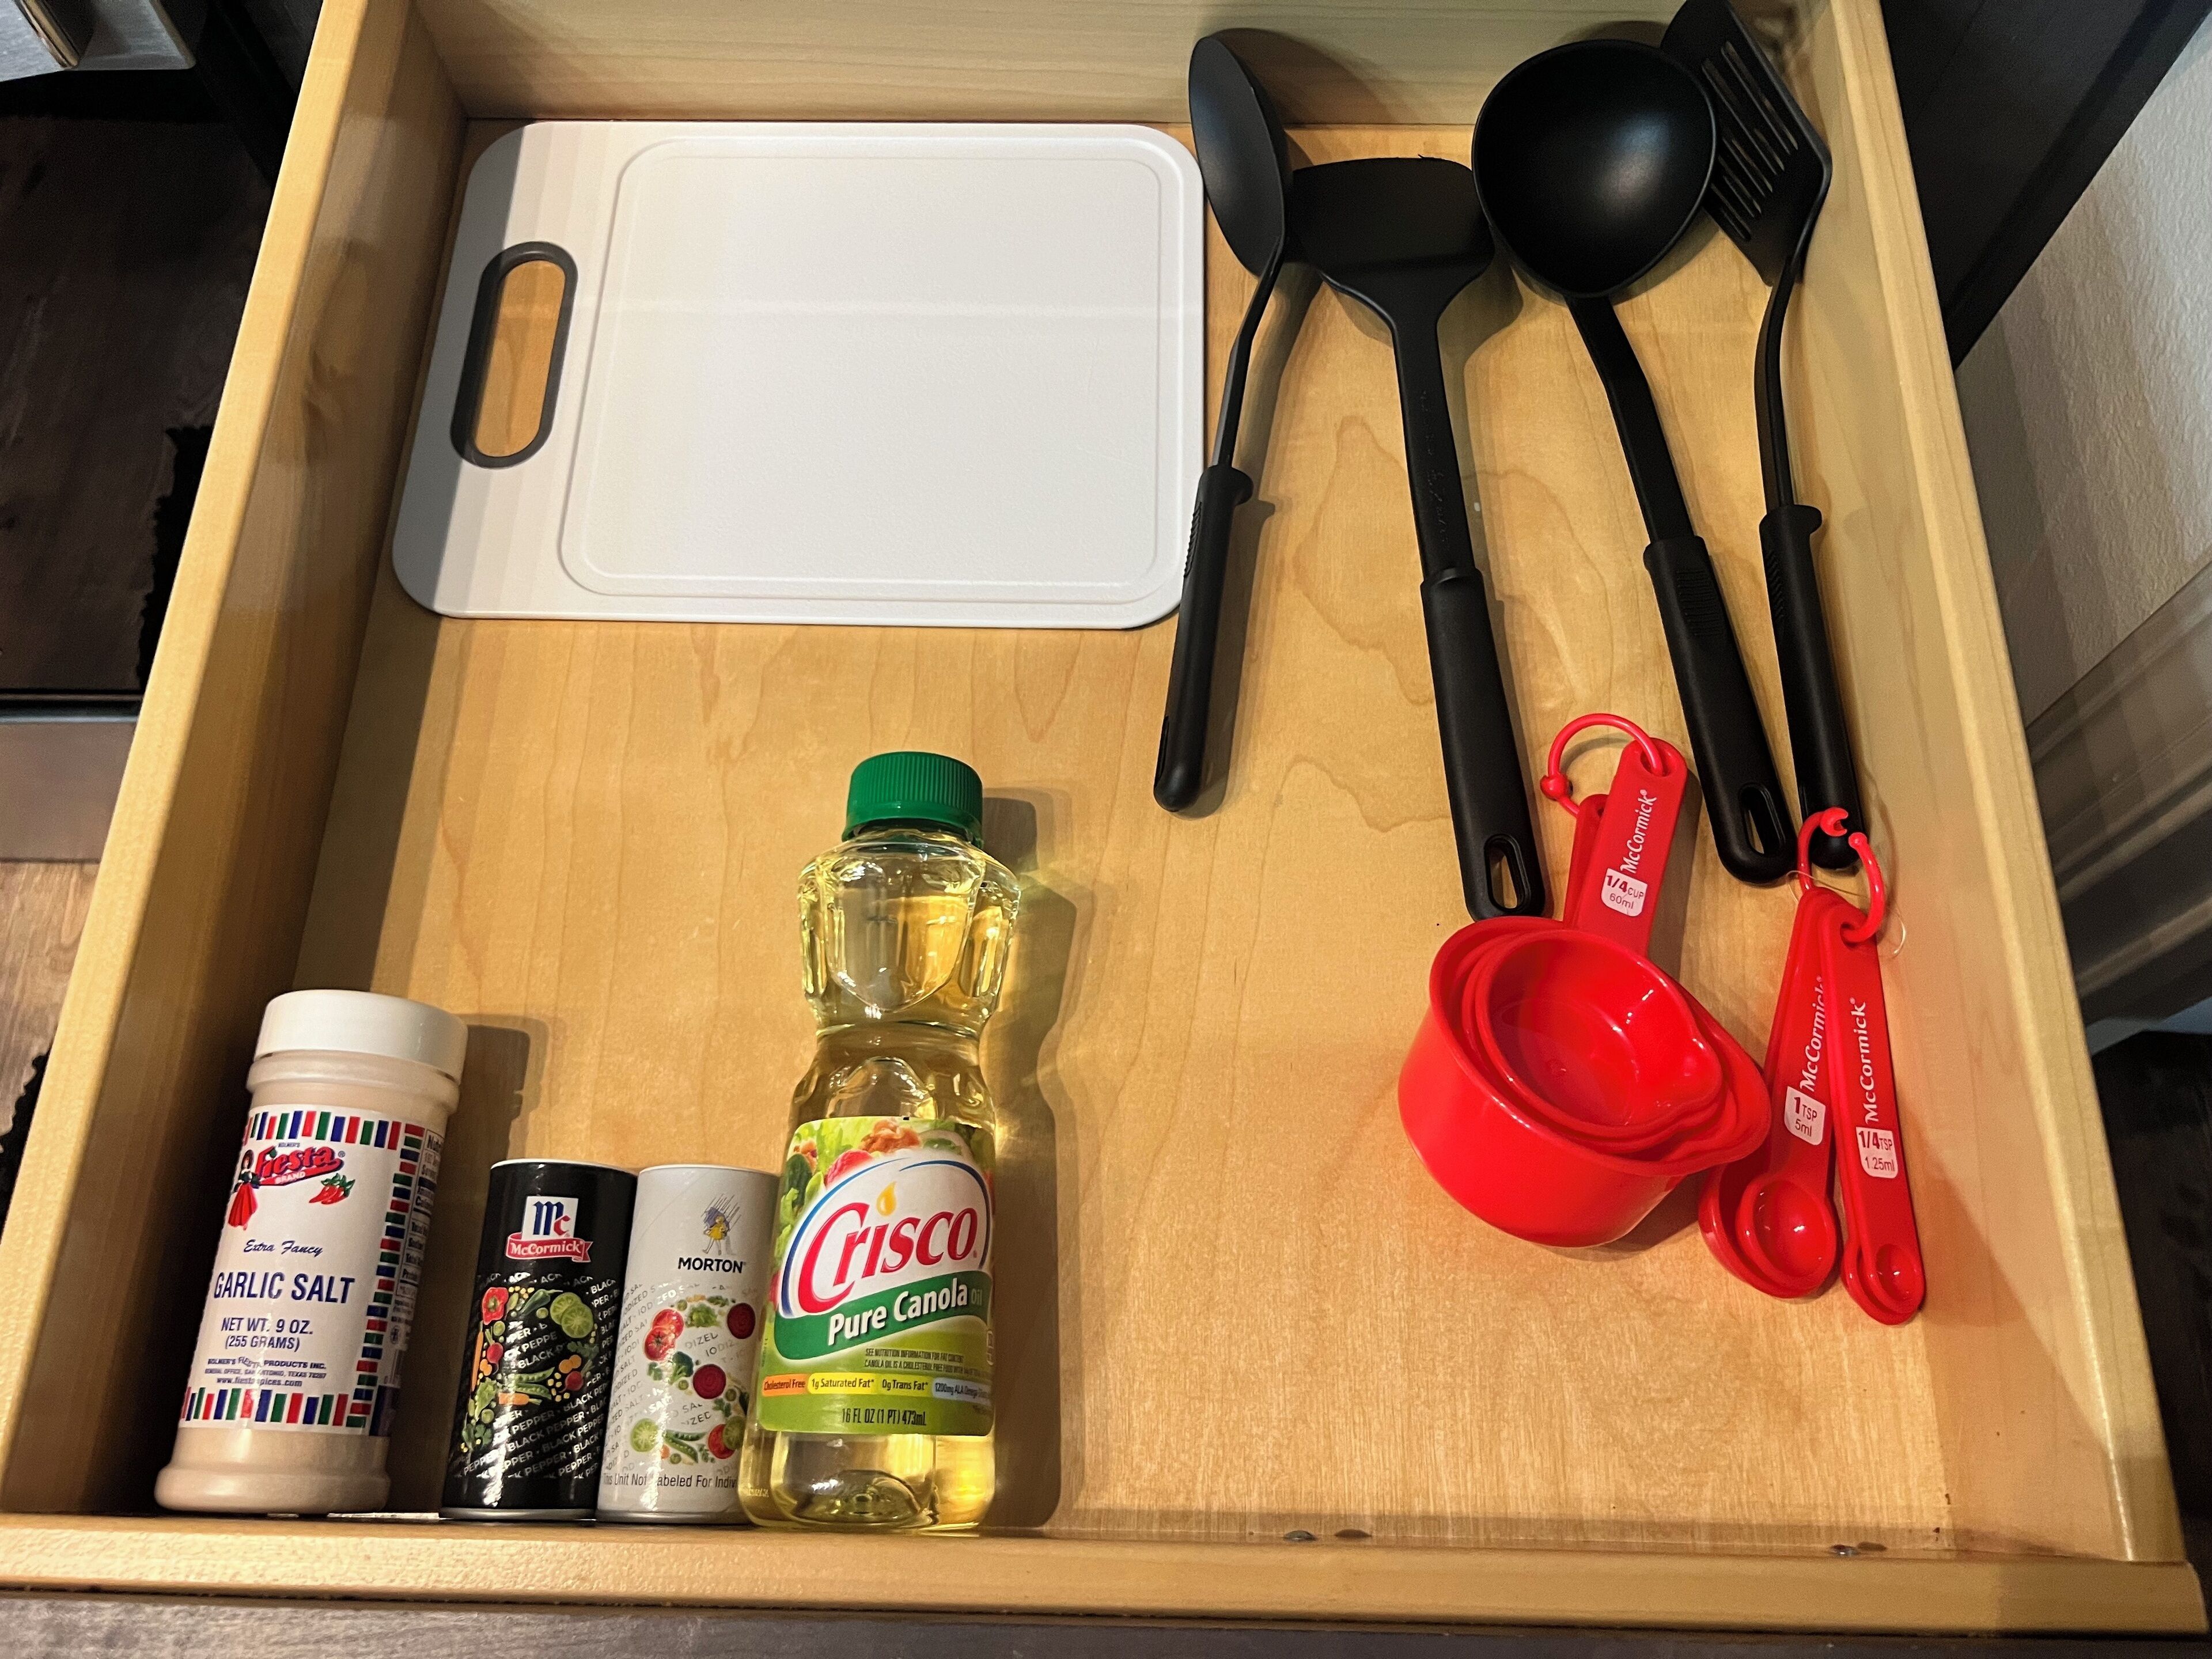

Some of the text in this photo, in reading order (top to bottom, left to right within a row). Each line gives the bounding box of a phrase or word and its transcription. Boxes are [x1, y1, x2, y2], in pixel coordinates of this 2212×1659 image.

[1620, 797, 1657, 874] McCormick
[1609, 893, 1634, 909] 60ml
[1850, 1001, 1879, 1124] McCormick
[1802, 1104, 1817, 1122] TSP
[1794, 1118, 1812, 1137] 5ml
[255, 1146, 340, 1179] Fiesta
[274, 1171, 306, 1184] BRAND
[244, 1239, 323, 1257] Extra Fancy
[510, 1241, 582, 1256] McCormick
[677, 1257, 744, 1274] MORTON
[798, 1202, 978, 1313] Crisco
[214, 1271, 355, 1304] GARLIC SALT
[828, 1305, 887, 1346] Pure
[893, 1277, 968, 1322] Canola
[221, 1317, 313, 1335] NET WT. 9 OZ.
[225, 1335, 300, 1353] (255 GRAMS)
[264, 1360, 308, 1368] PRODUCTS
[791, 1378, 805, 1389] Free
[812, 1379, 819, 1389] 1g
[820, 1378, 857, 1388] Saturated
[892, 1380, 912, 1390] Trans
[843, 1408, 850, 1423] 16
[853, 1408, 861, 1423] FL
[864, 1408, 875, 1423] OZ
[506, 1429, 545, 1452] BLACK
[558, 1452, 592, 1476] PEPPER
[657, 1475, 692, 1488] abeled
[696, 1475, 713, 1488] For
